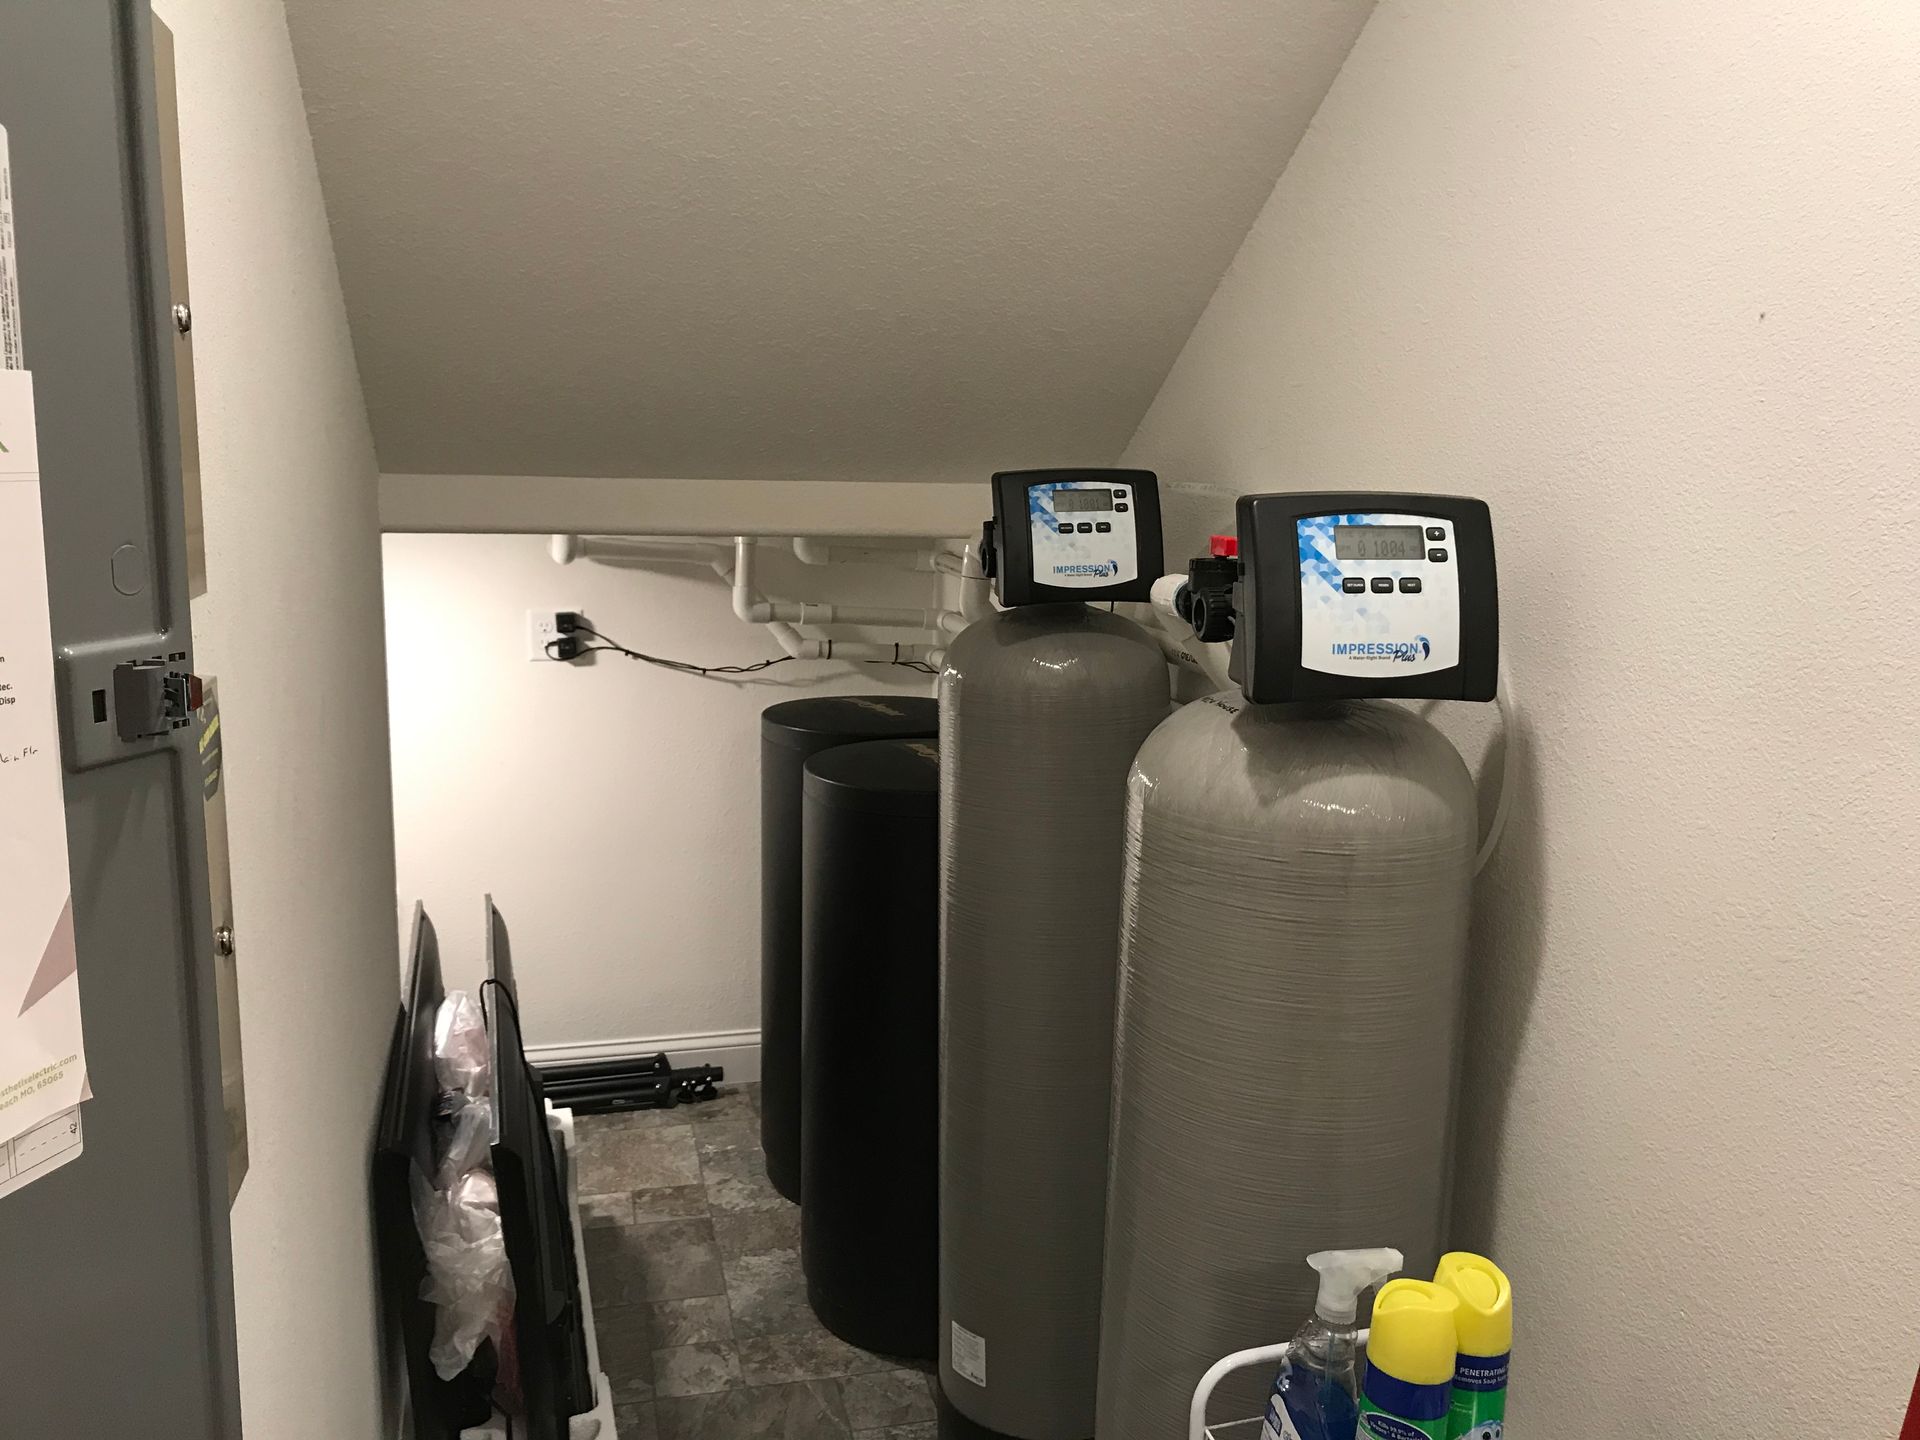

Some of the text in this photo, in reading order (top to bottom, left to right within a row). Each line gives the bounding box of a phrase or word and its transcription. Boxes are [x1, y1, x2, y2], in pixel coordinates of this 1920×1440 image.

[1053, 564, 1110, 574] IMPRESSION
[1332, 642, 1418, 655] IMPRESSION
[1393, 649, 1416, 663] Plus
